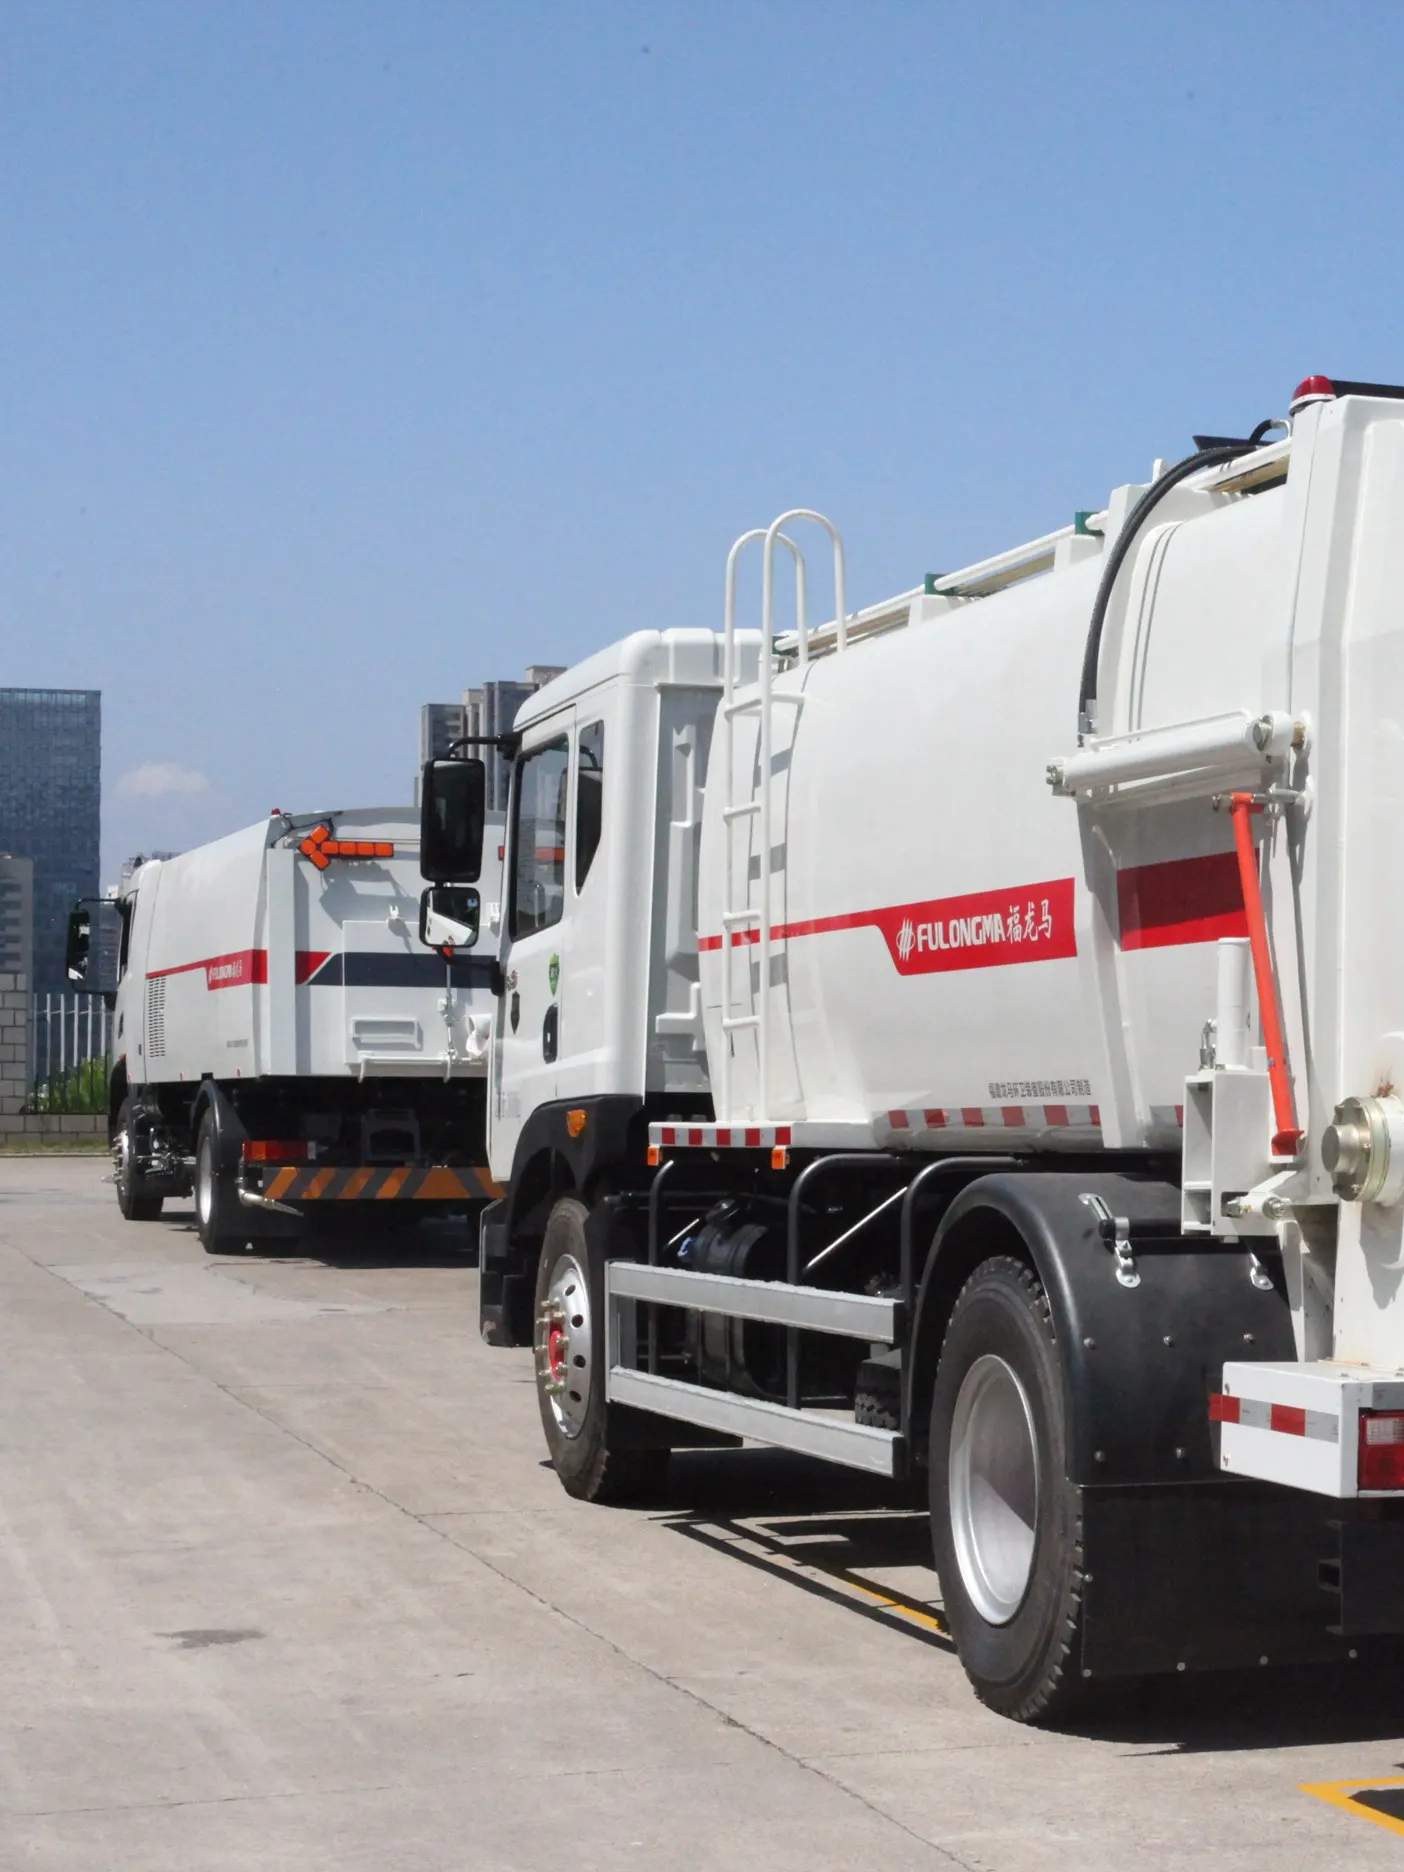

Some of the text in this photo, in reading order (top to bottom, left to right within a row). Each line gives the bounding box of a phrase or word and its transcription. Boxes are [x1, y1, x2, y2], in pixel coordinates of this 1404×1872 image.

[917, 899, 1053, 952] FULONGMA 福龙马
